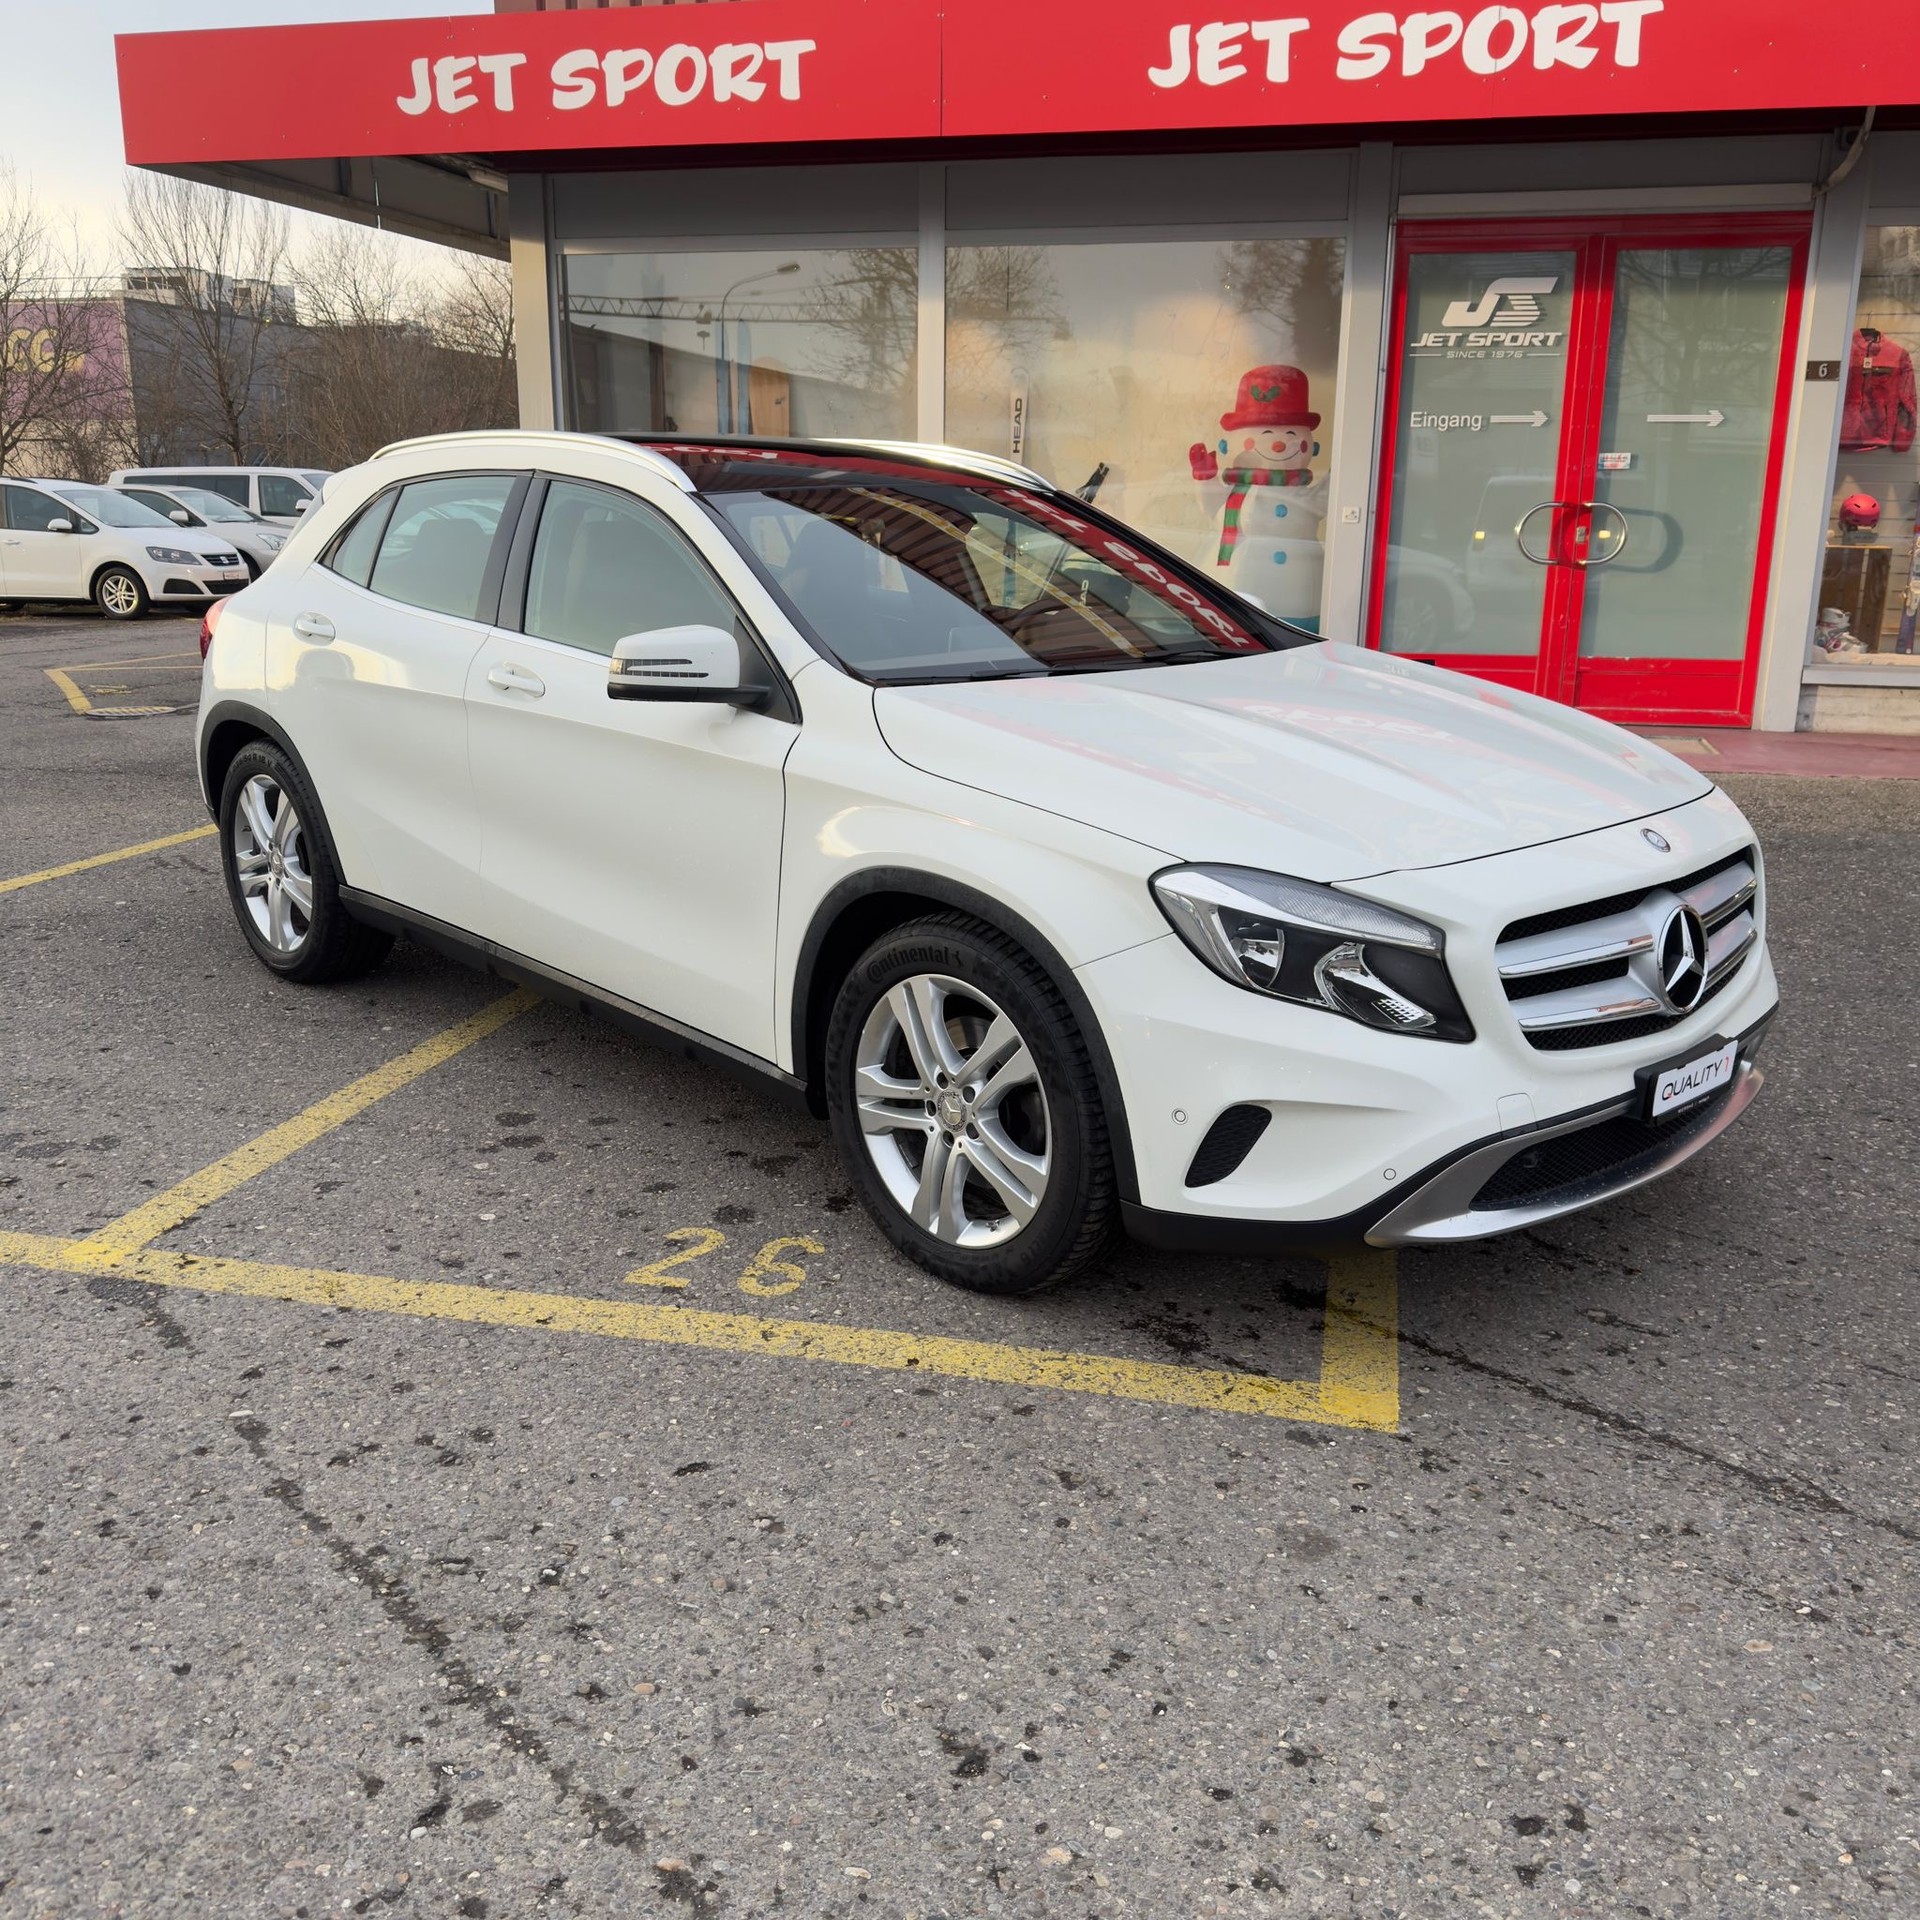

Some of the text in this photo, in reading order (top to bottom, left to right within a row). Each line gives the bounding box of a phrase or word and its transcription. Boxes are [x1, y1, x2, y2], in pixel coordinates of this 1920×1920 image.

[1148, 0, 1664, 88] JET SPORT
[397, 39, 817, 115] JET SPORT
[1410, 332, 1562, 347] JET SPORT
[1446, 350, 1524, 359] SINCE 1976
[1819, 363, 1828, 377] 6
[1013, 398, 1023, 453] HEAD
[1410, 411, 1482, 431] Eingang
[866, 944, 950, 984] Continental
[1661, 1059, 1723, 1101] QUALITY
[622, 1227, 826, 1297] 26
